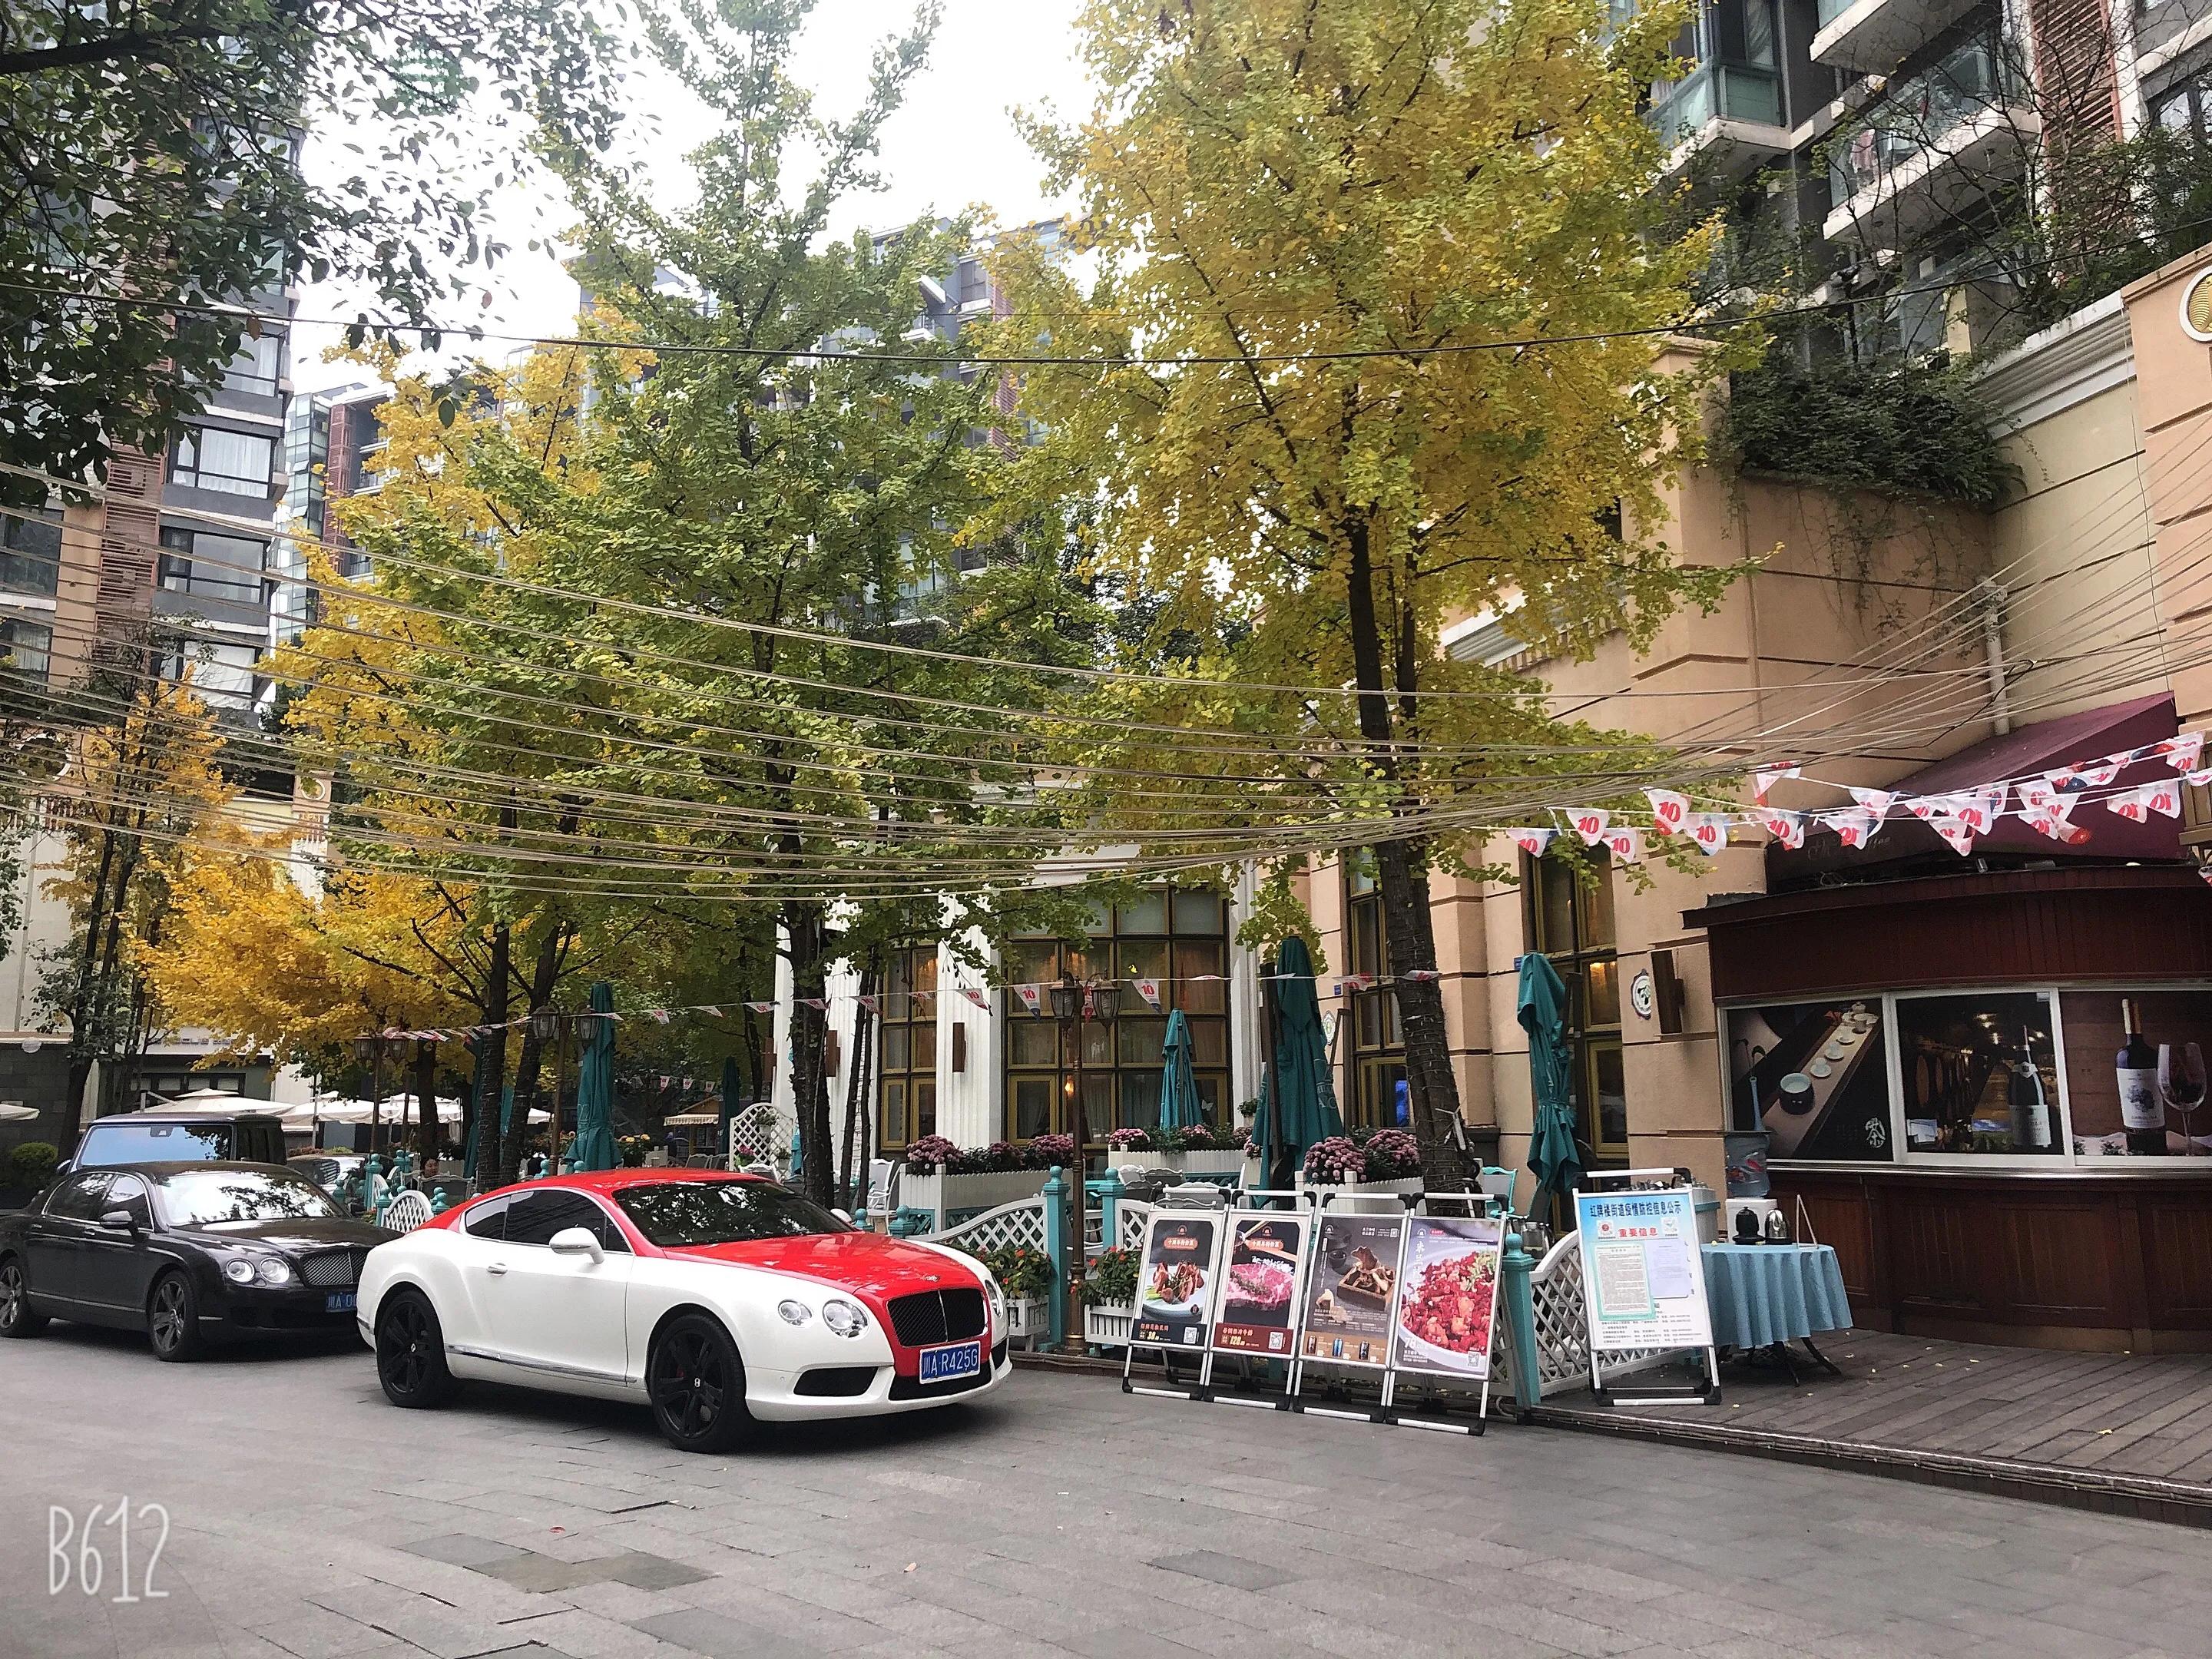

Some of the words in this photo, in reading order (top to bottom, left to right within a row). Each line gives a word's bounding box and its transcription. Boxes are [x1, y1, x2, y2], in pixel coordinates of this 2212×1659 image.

[1659, 801, 1681, 822] 10
[1578, 816, 1600, 834] 10
[1696, 825, 1717, 843] 10
[1611, 837, 1631, 854] 10
[1022, 989, 1036, 999] 10
[1141, 985, 1154, 995] 10
[1590, 1200, 1681, 1217] 红牌楼街道疫情防控信息公示
[1618, 1227, 1658, 1237] 重要信息
